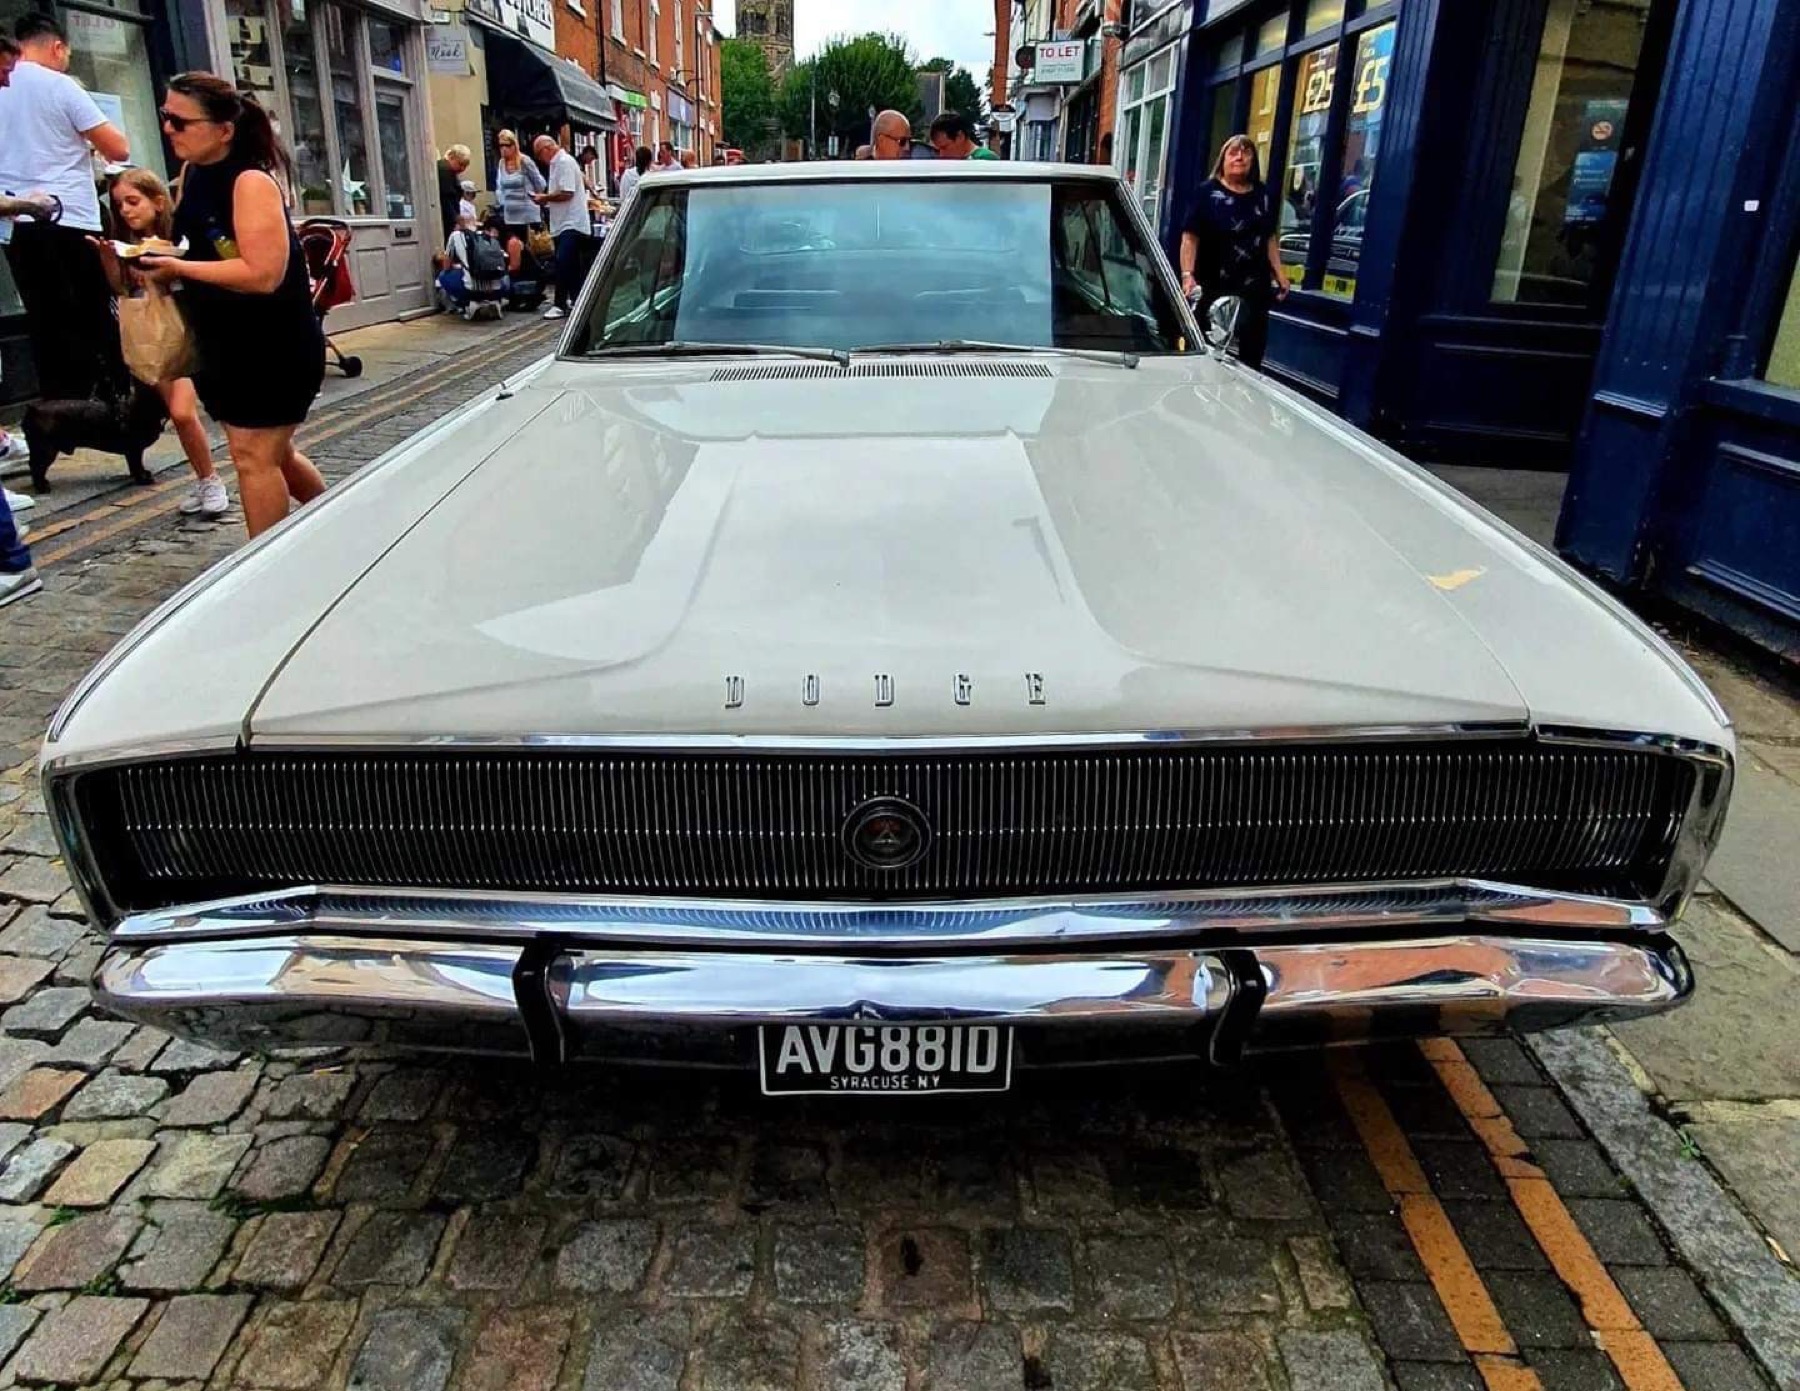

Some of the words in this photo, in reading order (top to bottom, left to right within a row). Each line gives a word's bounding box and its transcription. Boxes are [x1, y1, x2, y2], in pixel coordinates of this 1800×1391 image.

[1040, 47, 1055, 58] TO
[1058, 45, 1080, 57] LET
[1353, 57, 1391, 113] £5
[725, 673, 1047, 709] DODGE
